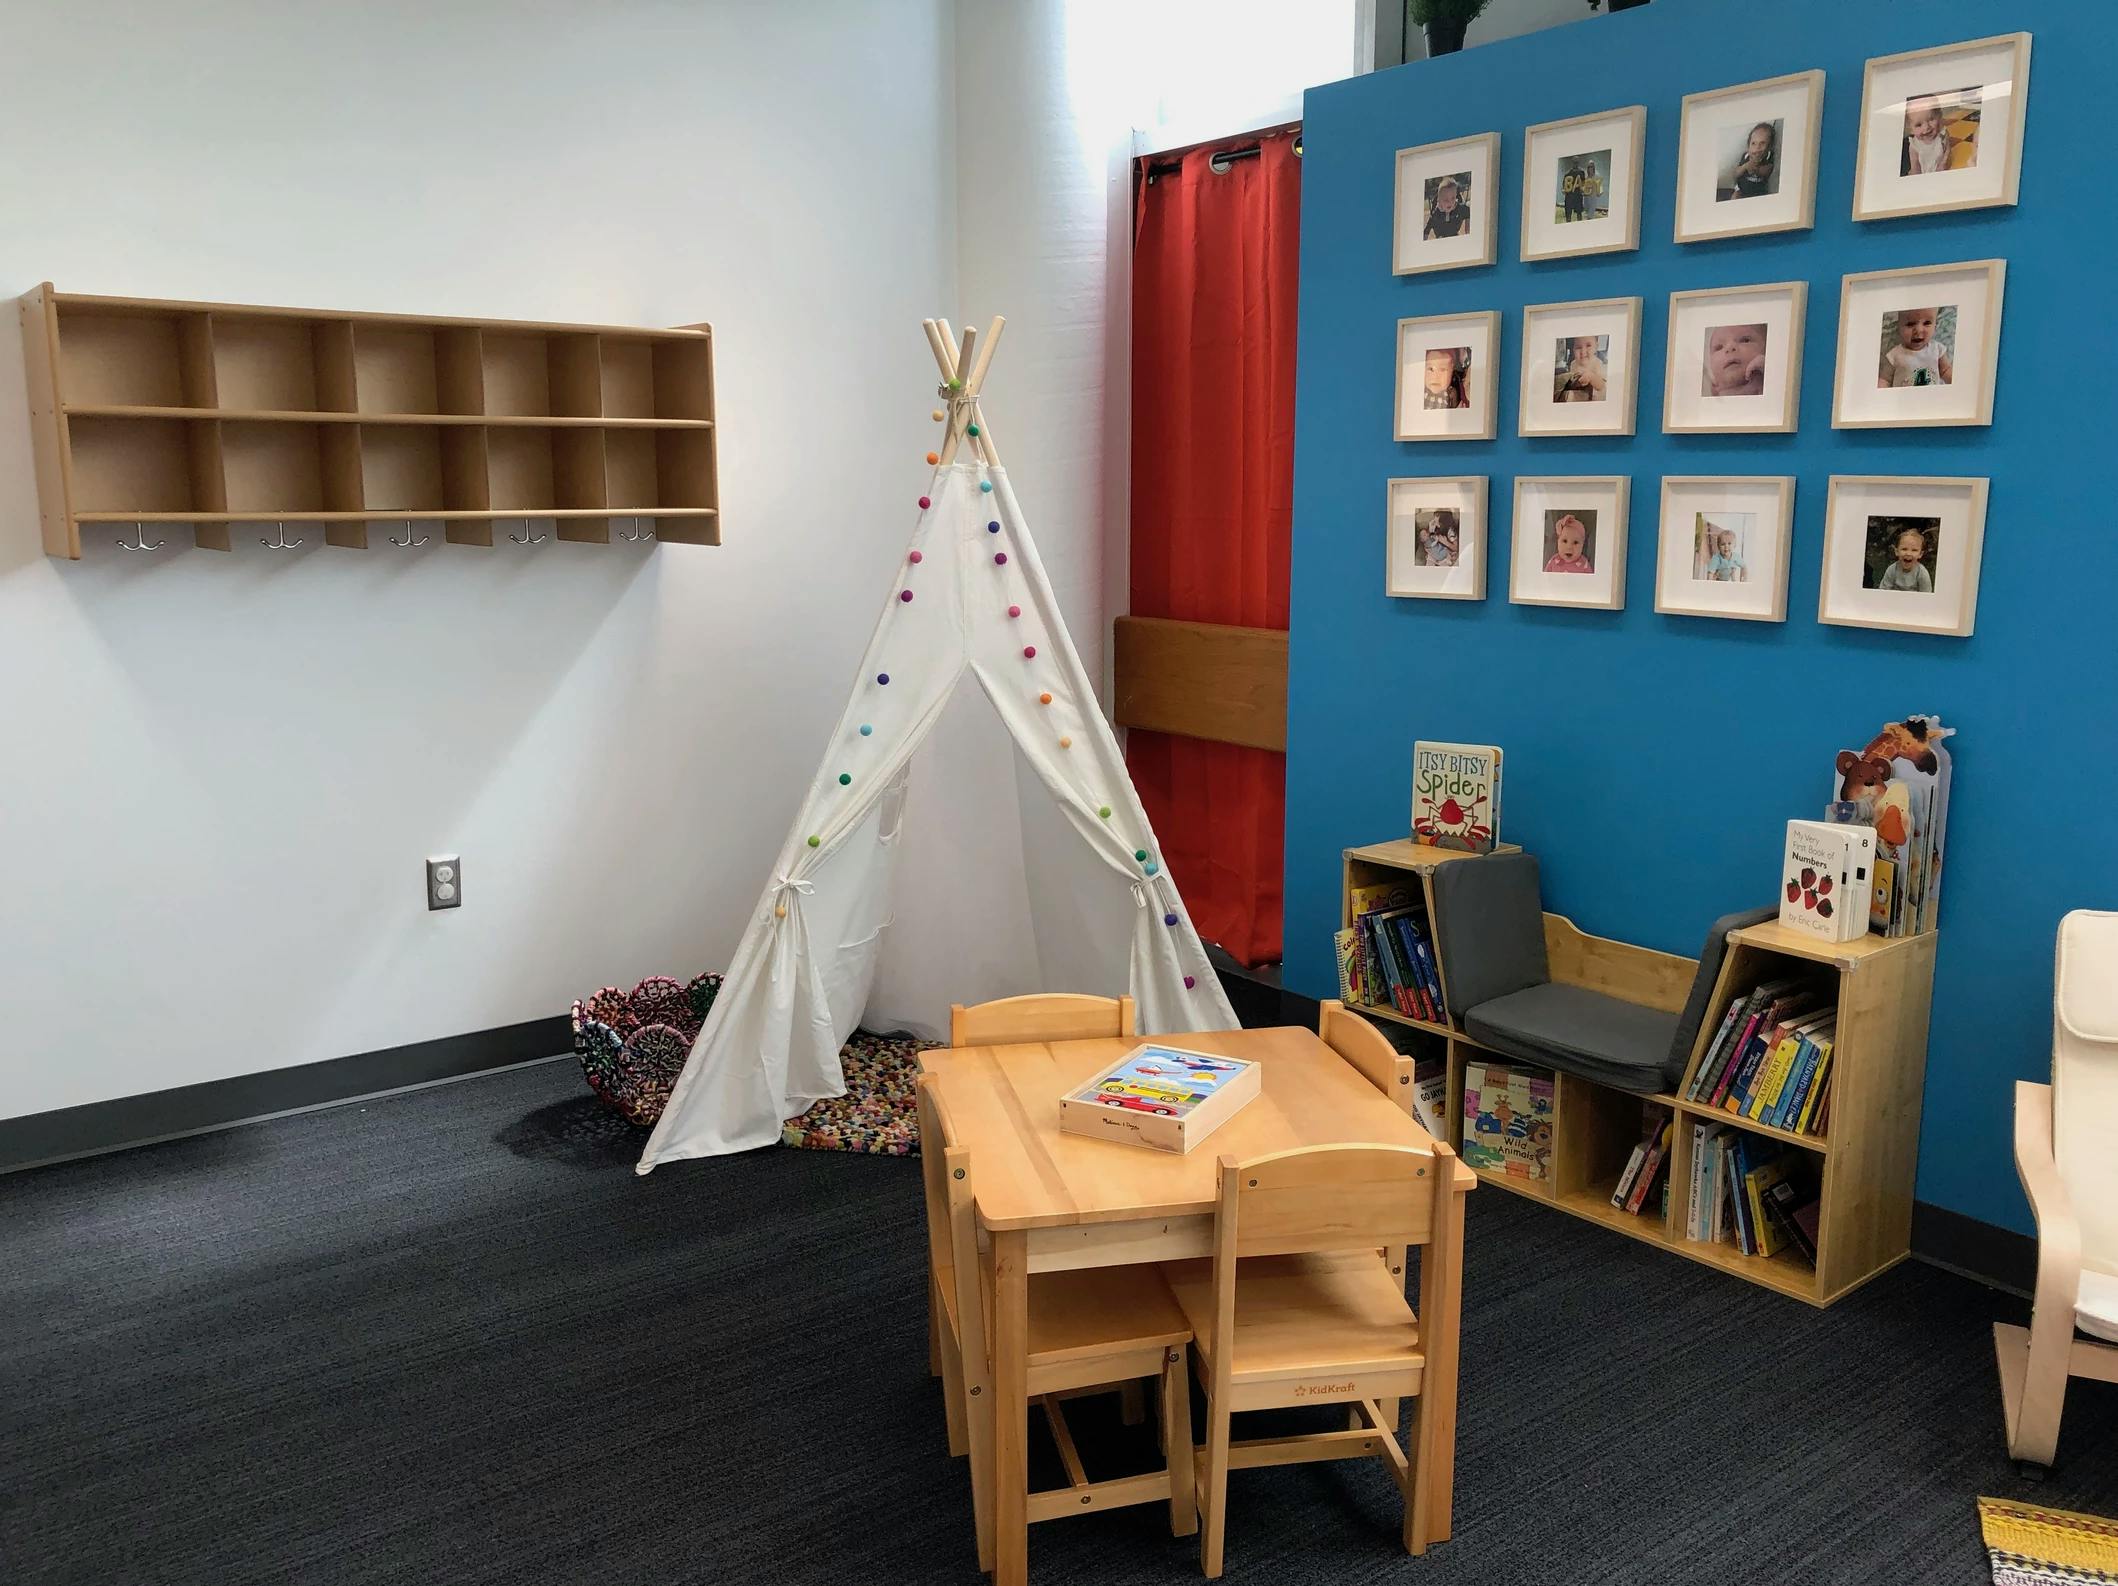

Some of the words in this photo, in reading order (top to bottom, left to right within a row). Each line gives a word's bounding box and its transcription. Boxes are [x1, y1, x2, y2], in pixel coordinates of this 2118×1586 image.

[1419, 751, 1448, 771] ITSY
[1449, 755, 1488, 776] BITSY
[1416, 769, 1486, 801] Spider
[1793, 830, 1804, 841] My
[1804, 834, 1821, 845] Very
[1862, 839, 1869, 848] 8
[1792, 840, 1806, 852] First
[1808, 845, 1825, 856] Book
[1827, 851, 1835, 860] of
[1844, 843, 1849, 852] 1
[1792, 851, 1828, 869] Numbers
[1788, 912, 1797, 923] by
[1798, 914, 1811, 927] Eric
[1758, 1057, 1782, 1103] JAMBERRY
[1800, 1058, 1817, 1089] BARNYARD
[1421, 1092, 1431, 1102] GO
[1503, 1136, 1528, 1150] Wild
[1497, 1145, 1535, 1161] Animals
[1309, 1382, 1356, 1395] KidKraft
